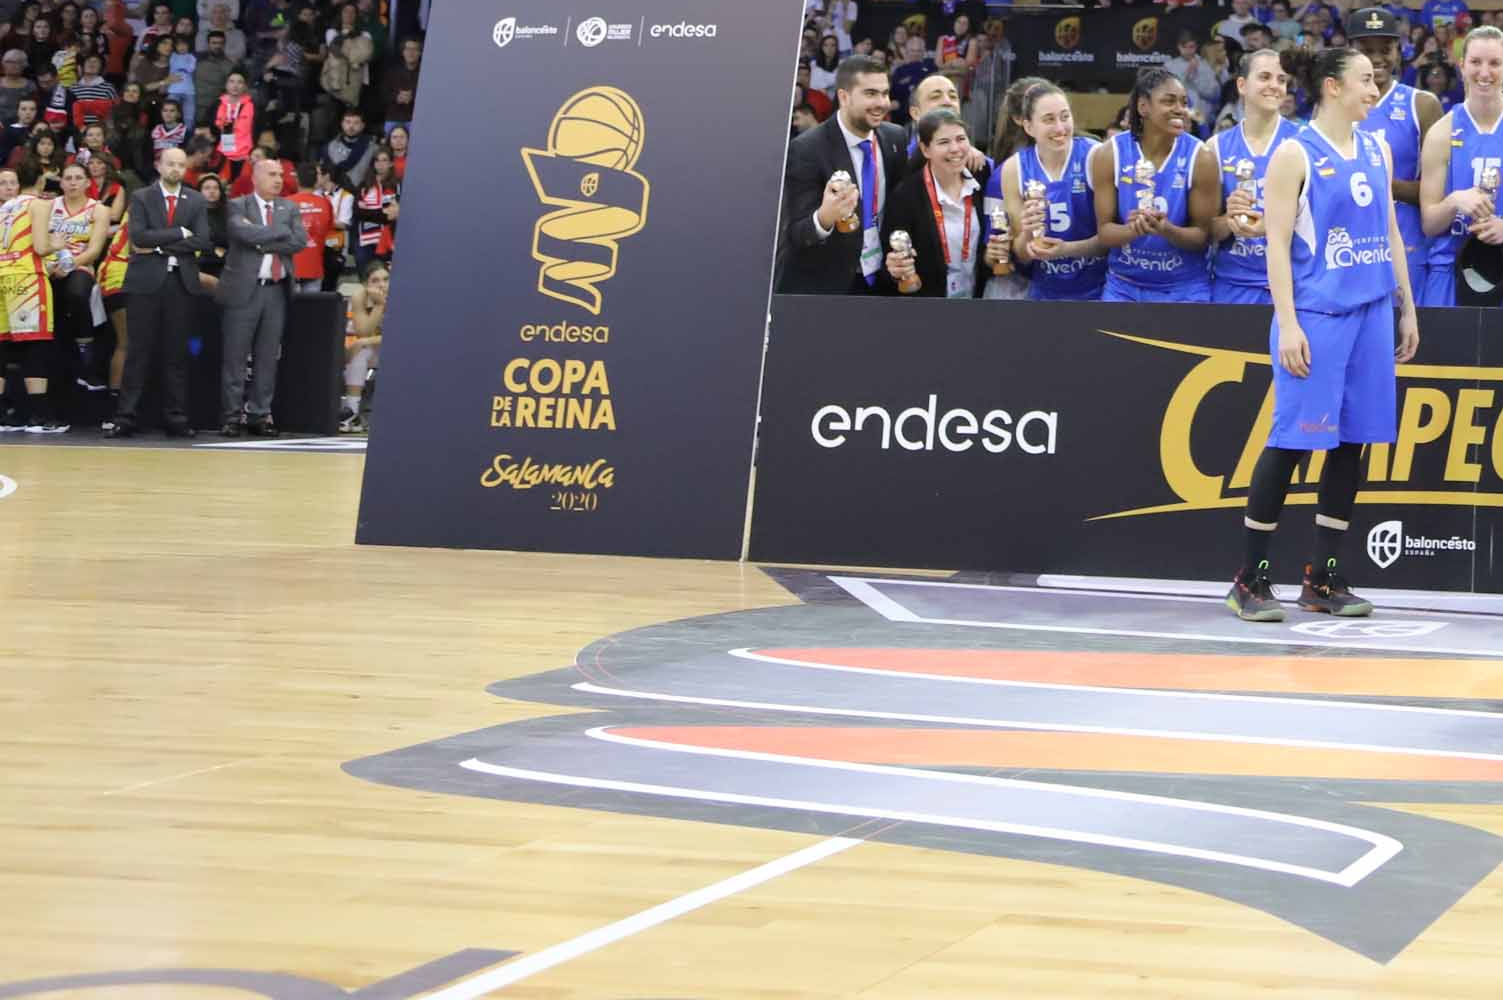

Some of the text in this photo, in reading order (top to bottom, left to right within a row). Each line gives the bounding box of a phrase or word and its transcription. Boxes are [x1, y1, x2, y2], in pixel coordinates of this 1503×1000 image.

[650, 21, 717, 37] endesa
[1350, 172, 1373, 207] 6
[519, 320, 610, 343] endesa
[503, 357, 611, 395] COPA
[493, 396, 513, 411] DE
[515, 397, 617, 430] REINA
[490, 411, 512, 427] LA
[811, 394, 1059, 454] endesa
[550, 493, 598, 511] 2020
[1405, 536, 1476, 551] baloncesto
